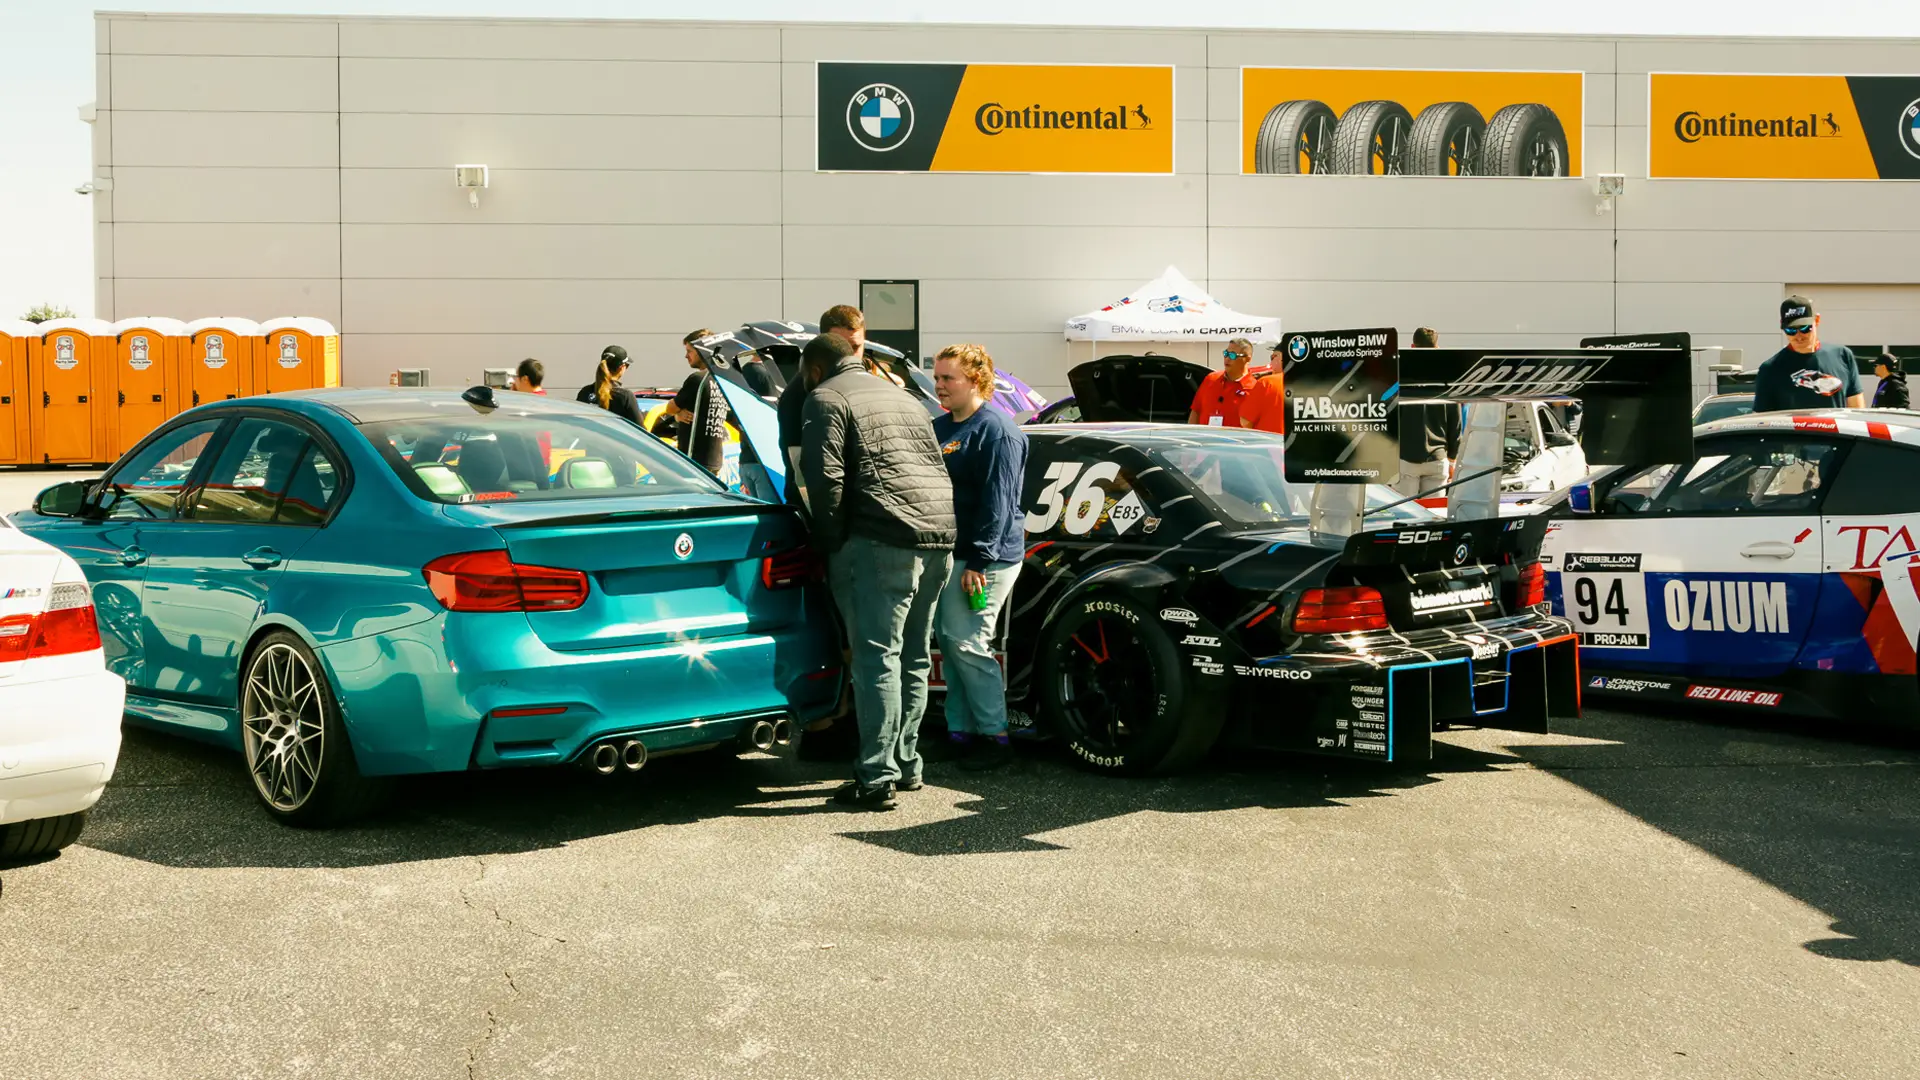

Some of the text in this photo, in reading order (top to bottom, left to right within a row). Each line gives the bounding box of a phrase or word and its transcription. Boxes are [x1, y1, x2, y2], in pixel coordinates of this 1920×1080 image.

[855, 86, 905, 107] BMW
[974, 102, 1128, 136] Continental
[1674, 111, 1818, 143] Continental
[1200, 326, 1262, 335] CHAPTER
[1311, 334, 1388, 349] Winslow BMW
[1316, 348, 1383, 359] of Colorado Springs
[1293, 393, 1388, 419] FABworks
[1294, 423, 1388, 432] MACHINE & DESIGN
[1023, 461, 1122, 536] 36
[1112, 505, 1140, 520] E85
[1398, 530, 1431, 544] 50
[1410, 581, 1494, 610] bimmerworld
[1575, 576, 1630, 626] 94
[1084, 600, 1140, 624] Hoosier
[1663, 579, 1790, 634] OZIUM
[1180, 635, 1222, 648] ATL
[1593, 634, 1638, 646] PRO-AM
[1246, 666, 1313, 680] HYPERCO
[1605, 683, 1645, 692] SUPPLY
[1610, 678, 1671, 690] JOHNSTONE
[1688, 685, 1779, 706] RED LINE OIL
[1069, 741, 1125, 767] Hoosier
